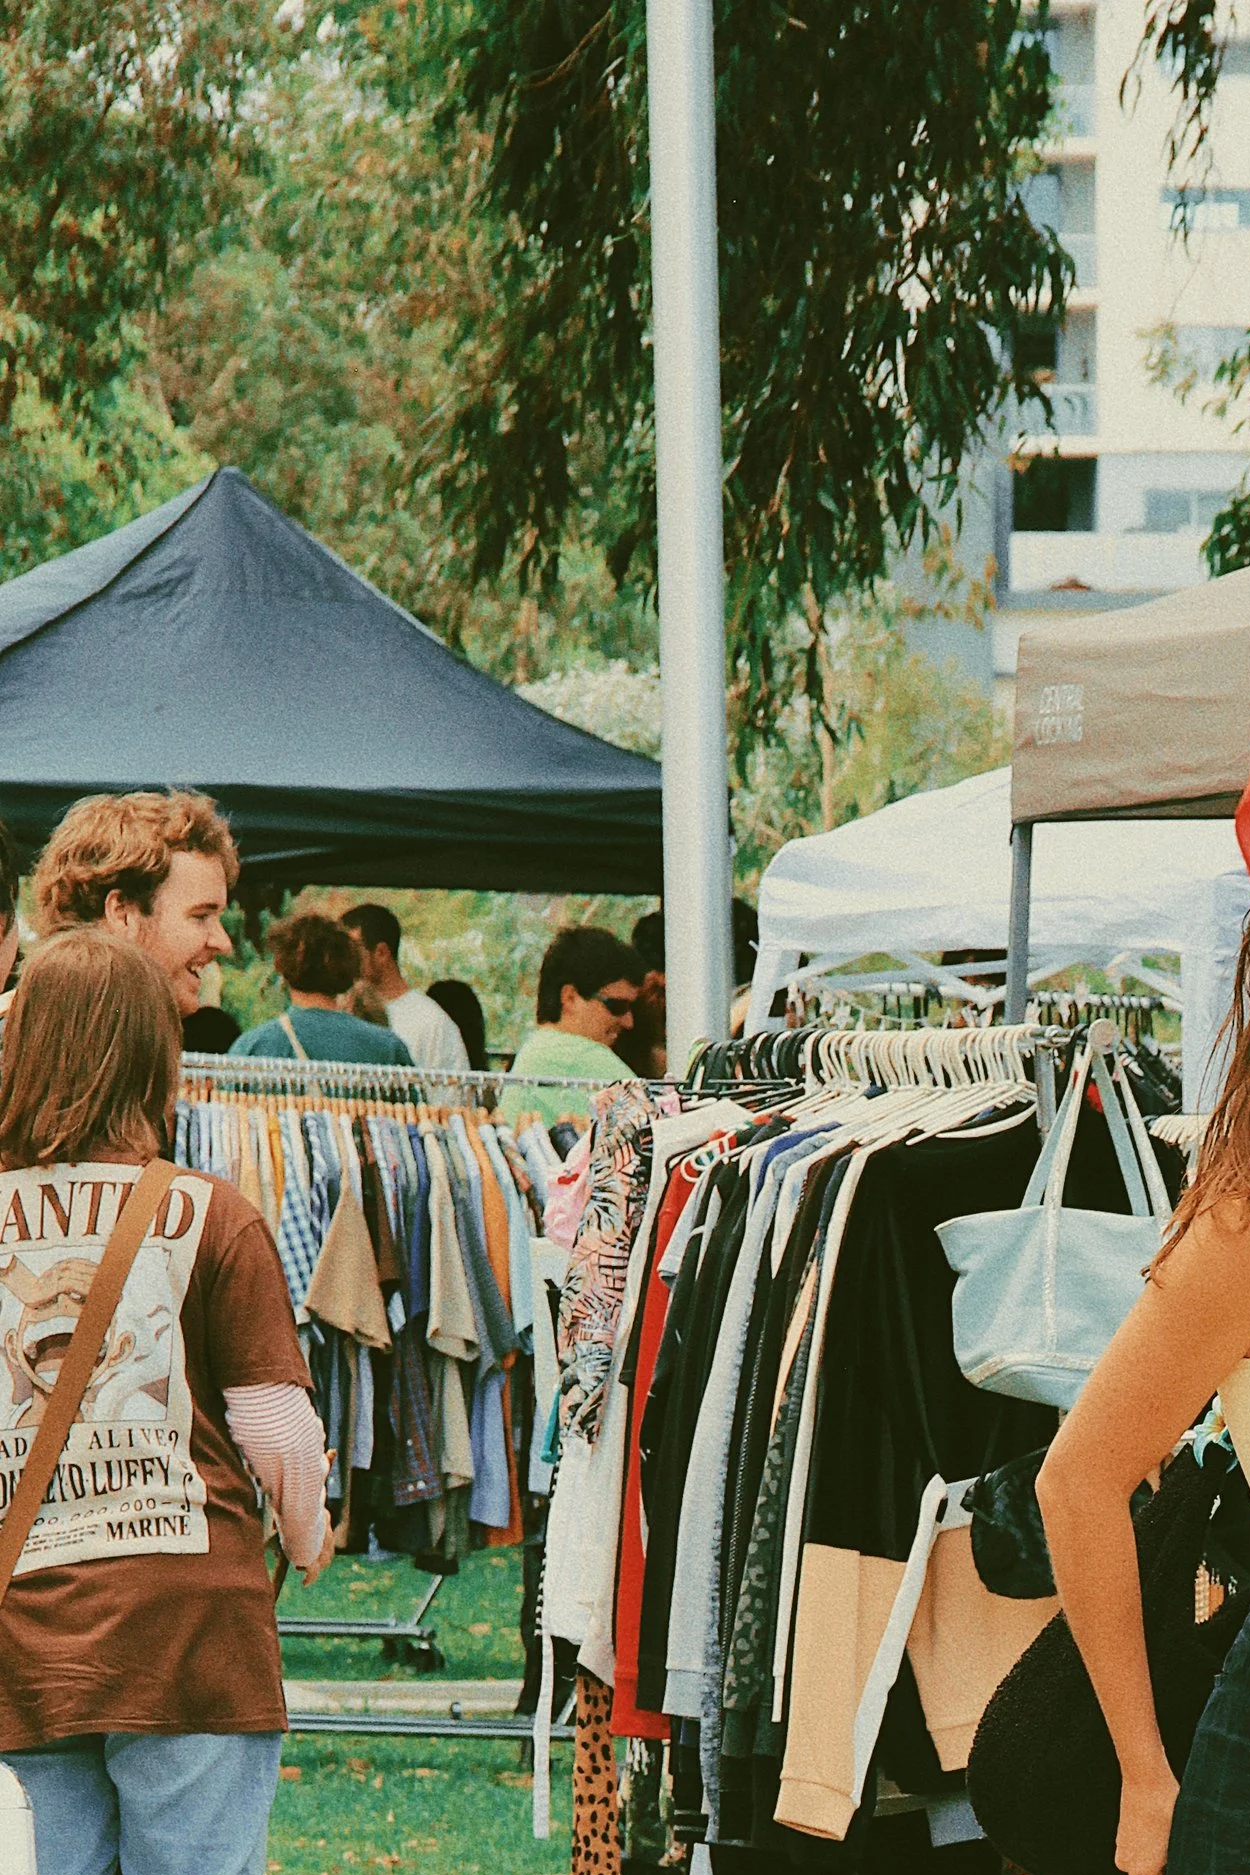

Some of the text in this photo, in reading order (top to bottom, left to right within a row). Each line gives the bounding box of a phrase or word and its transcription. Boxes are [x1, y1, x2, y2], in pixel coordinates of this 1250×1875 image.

[0, 1181, 195, 1246] ANTD
[0, 1436, 29, 1460] AD
[106, 1515, 192, 1542] MARINE
